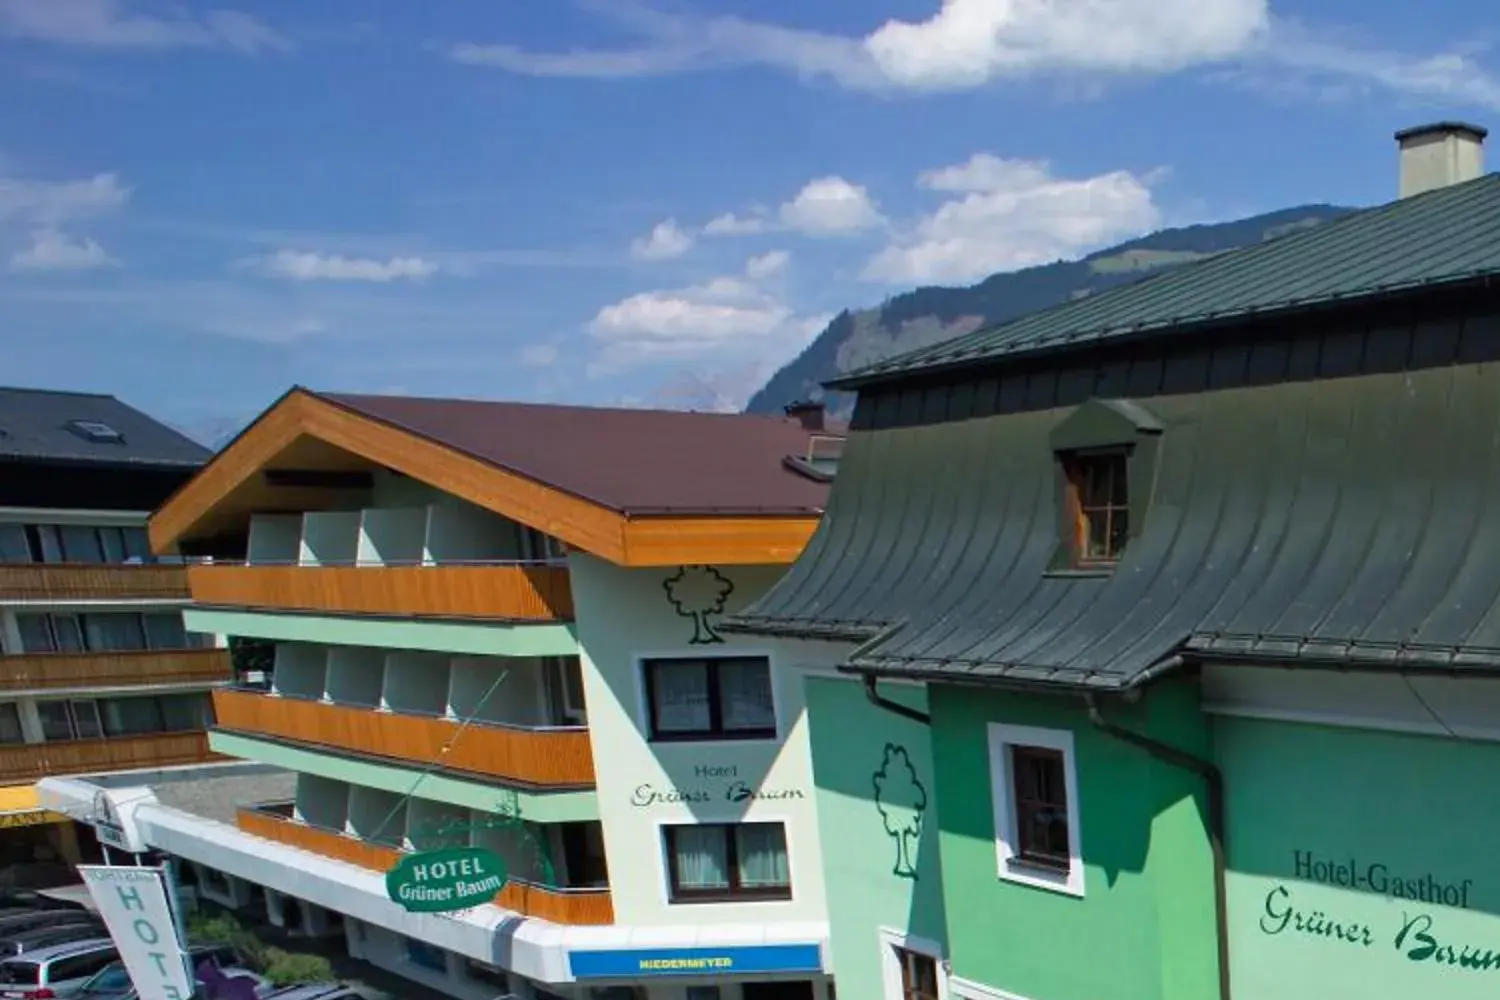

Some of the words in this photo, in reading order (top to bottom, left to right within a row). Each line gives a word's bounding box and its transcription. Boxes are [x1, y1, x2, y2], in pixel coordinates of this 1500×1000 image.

[694, 765, 738, 778] Hotel
[631, 783, 711, 806] Grüner
[726, 781, 805, 803] Baum
[412, 857, 485, 882] HOTEL
[1293, 850, 1473, 908] Hotel-Gasthof
[399, 883, 452, 901] Grüner
[455, 874, 501, 898] Baum
[1260, 885, 1373, 946] Grüner
